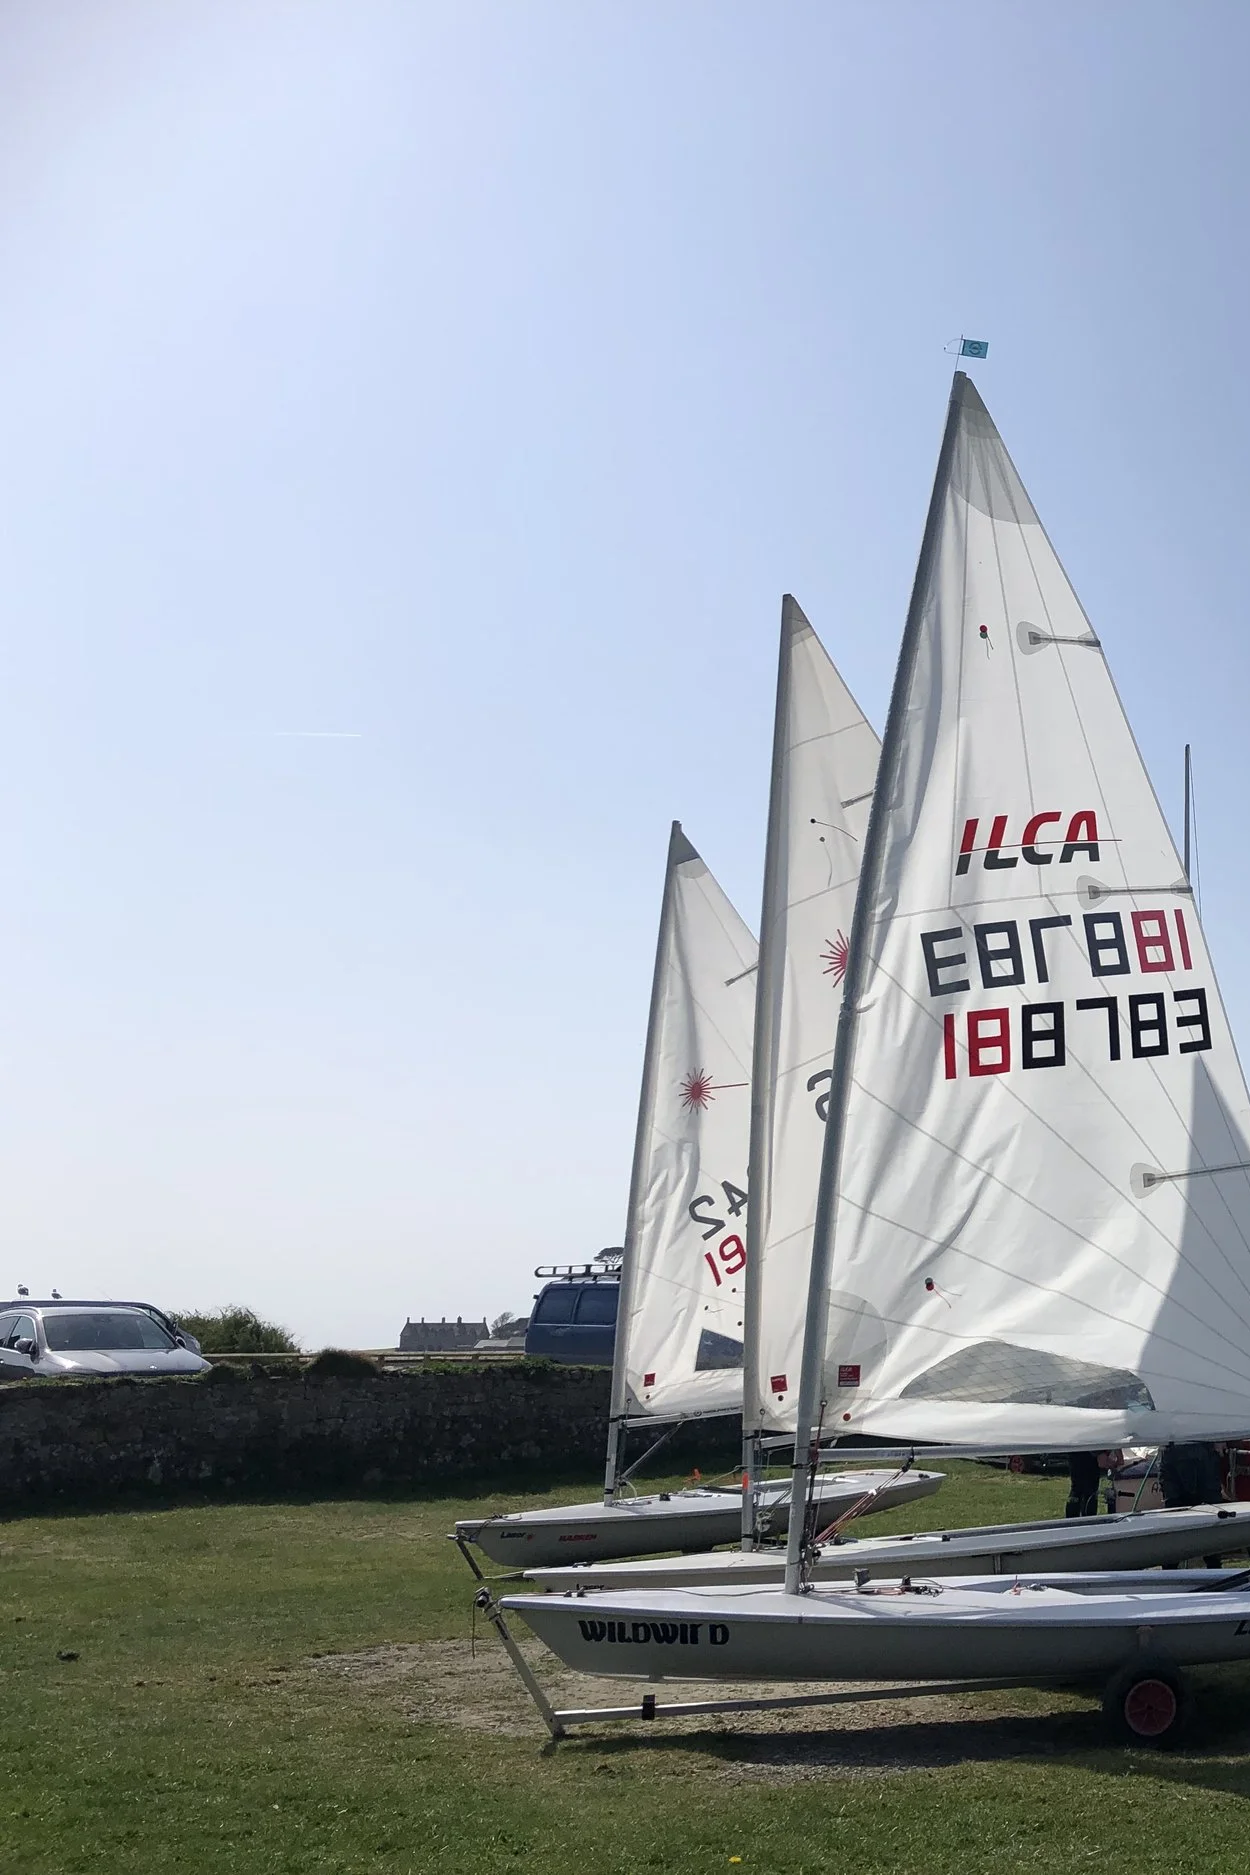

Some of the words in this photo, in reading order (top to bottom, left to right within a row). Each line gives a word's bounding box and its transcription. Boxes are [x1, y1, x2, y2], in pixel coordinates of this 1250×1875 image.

[955, 810, 1101, 876] ILCA
[943, 987, 1213, 1081] 188783
[704, 1234, 747, 1287] 19
